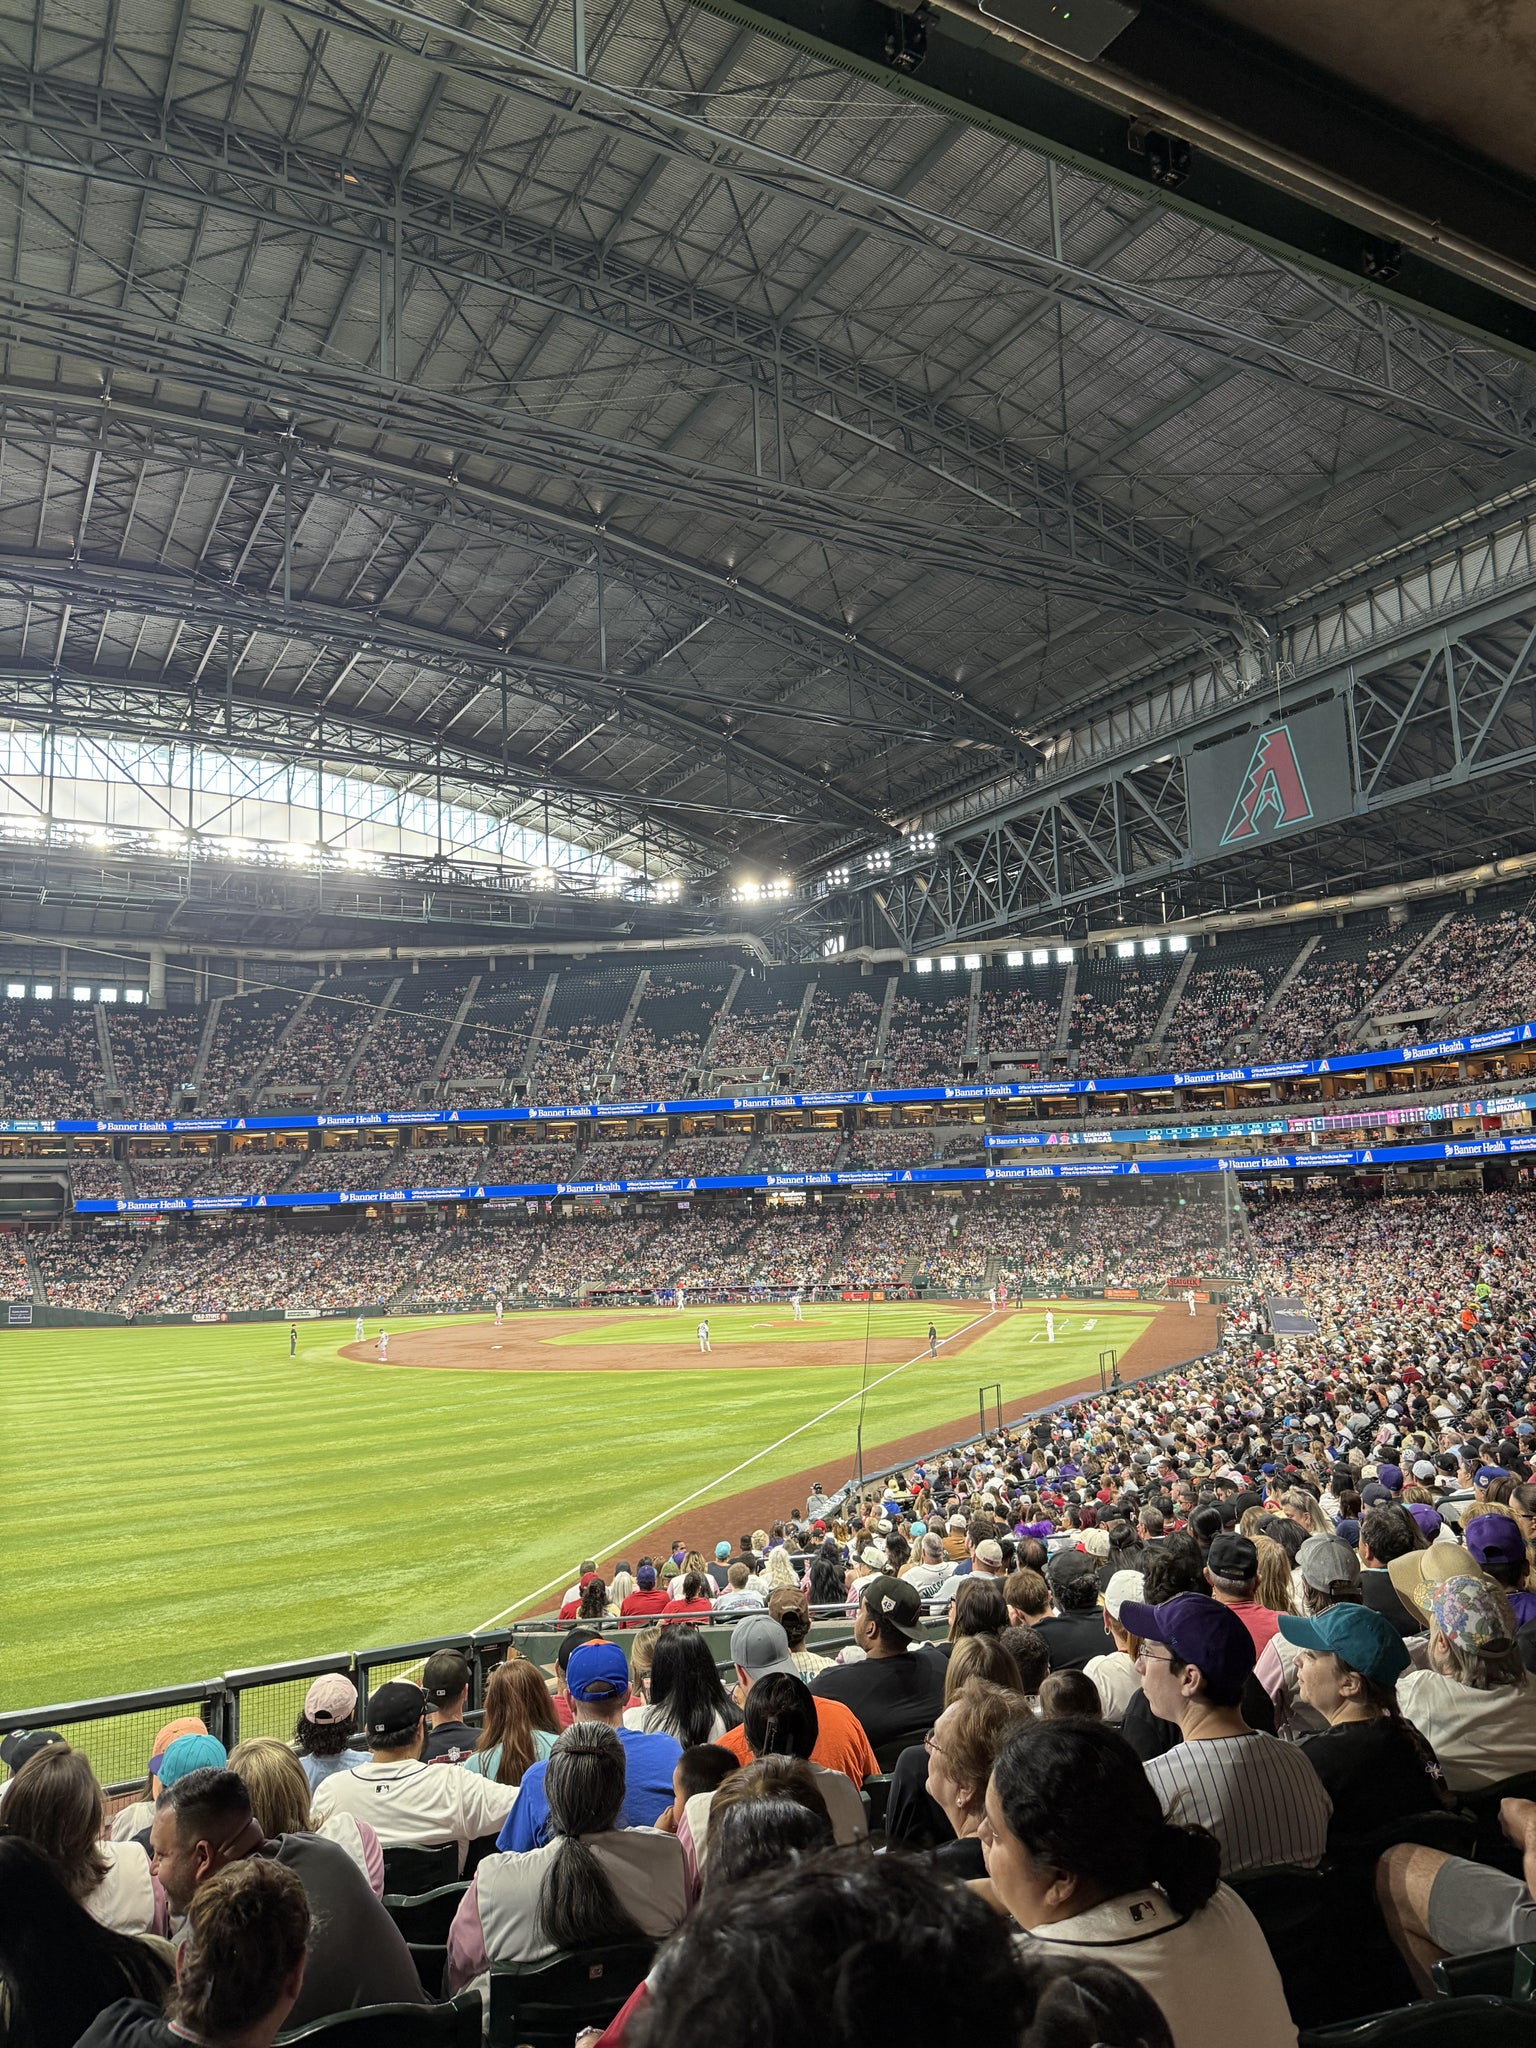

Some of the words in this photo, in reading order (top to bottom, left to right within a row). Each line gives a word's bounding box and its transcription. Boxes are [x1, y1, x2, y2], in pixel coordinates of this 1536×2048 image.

[1413, 1046, 1439, 1058] Banner
[1440, 1040, 1464, 1054] Health
[1184, 1074, 1215, 1083] Banner
[1216, 1070, 1245, 1081] Health
[955, 1089, 984, 1097] Banner
[985, 1086, 1012, 1095] Health
[743, 1099, 770, 1108] Banner
[771, 1097, 796, 1106] Health
[538, 1108, 566, 1116] Banner
[567, 1106, 591, 1115] Health
[327, 1117, 355, 1125] Banner
[356, 1115, 382, 1124] Health
[108, 1123, 138, 1131] Banner
[139, 1122, 167, 1131] Health
[1455, 1144, 1482, 1154] Banner
[1483, 1140, 1506, 1153] Health
[1261, 1157, 1289, 1167] Health
[996, 1169, 1025, 1178] Banner
[1027, 1167, 1054, 1177] Health
[776, 1176, 805, 1185] Banner
[806, 1174, 831, 1184] Health
[567, 1185, 595, 1193] Banner
[595, 1182, 621, 1192] Health
[350, 1193, 379, 1202] Banner
[380, 1191, 405, 1200] Health
[128, 1201, 159, 1210] Banner
[160, 1199, 187, 1209] Health
